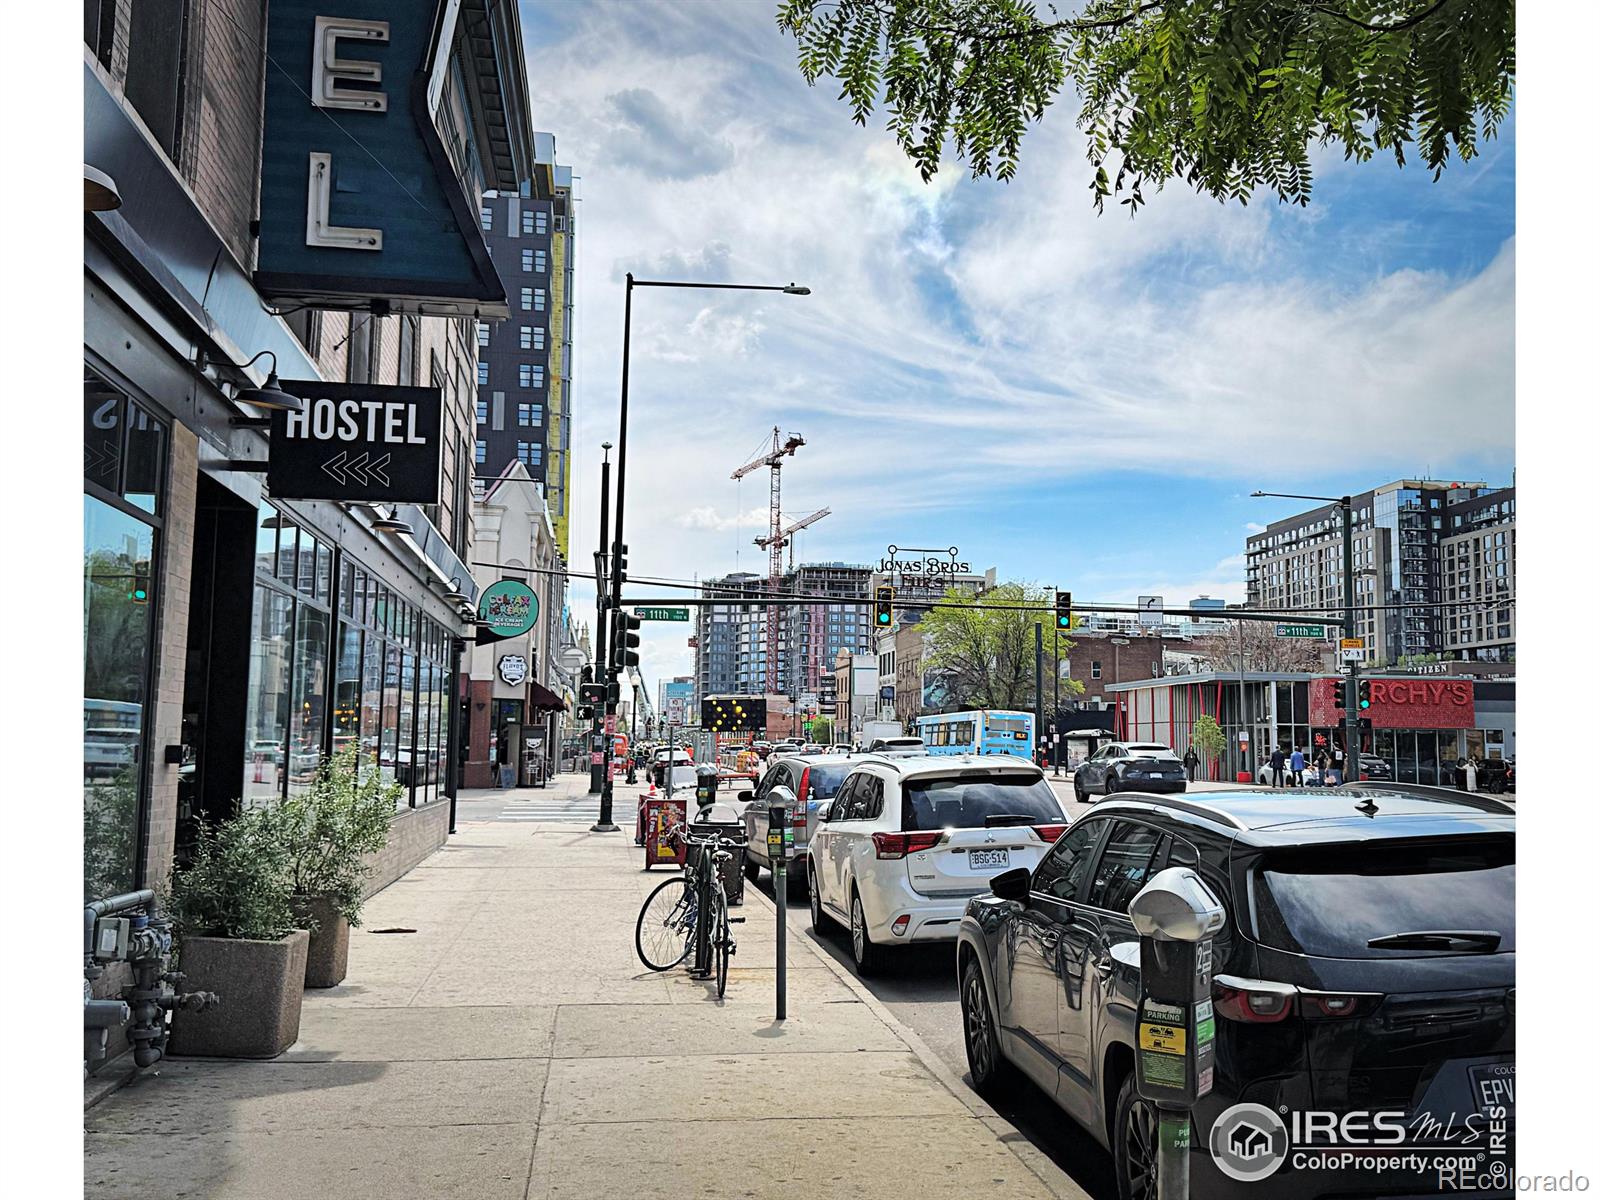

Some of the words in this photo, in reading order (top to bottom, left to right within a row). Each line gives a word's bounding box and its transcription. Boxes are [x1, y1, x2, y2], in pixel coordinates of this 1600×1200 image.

[286, 398, 427, 445] HOSTEL
[875, 558, 922, 573] JONAS
[649, 610, 669, 619] 11th
[1291, 627, 1309, 636] 11th
[1370, 682, 1468, 706] RCHY'S
[1147, 1010, 1181, 1022] PARKING
